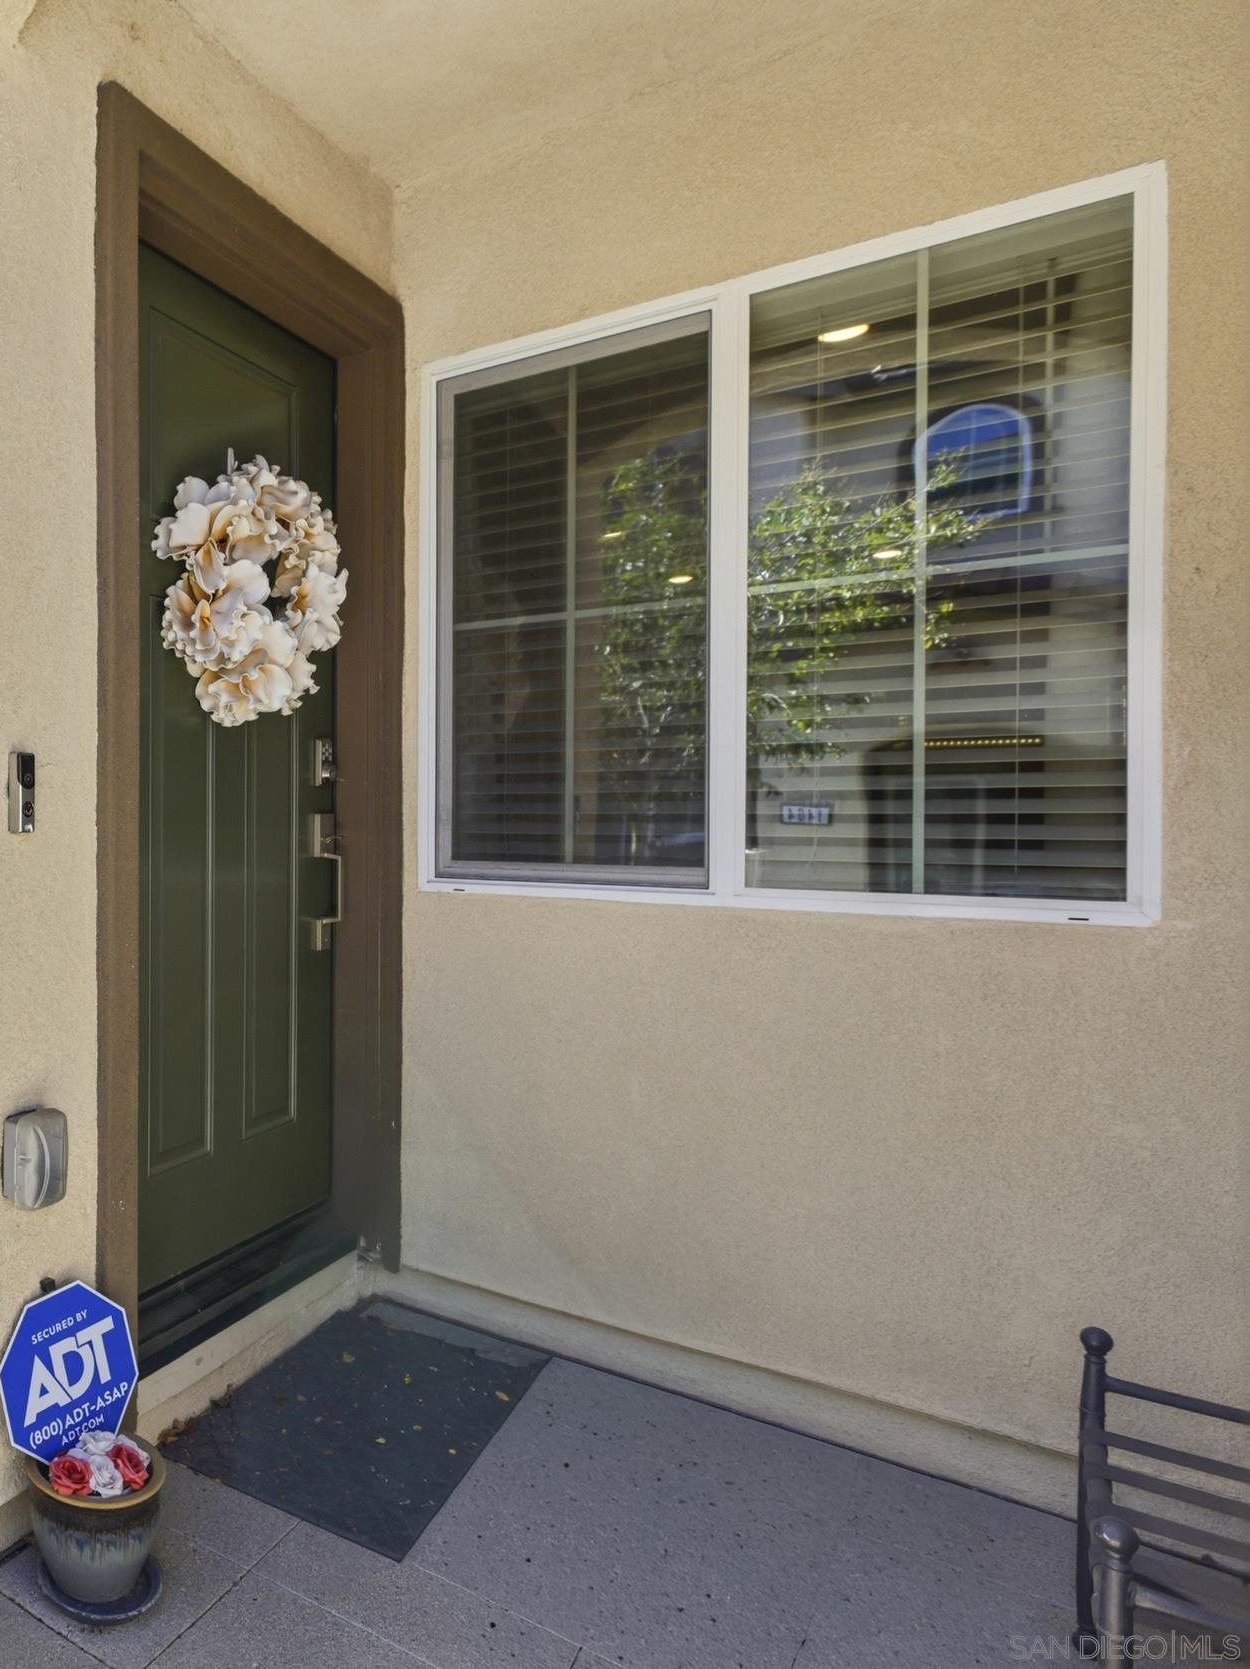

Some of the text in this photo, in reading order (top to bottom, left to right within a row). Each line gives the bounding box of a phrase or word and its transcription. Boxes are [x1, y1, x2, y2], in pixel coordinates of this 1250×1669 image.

[31, 1309, 88, 1345] SECURED BY
[23, 1315, 115, 1428] ADT
[29, 1381, 129, 1449] (800) ADT-ASAP
